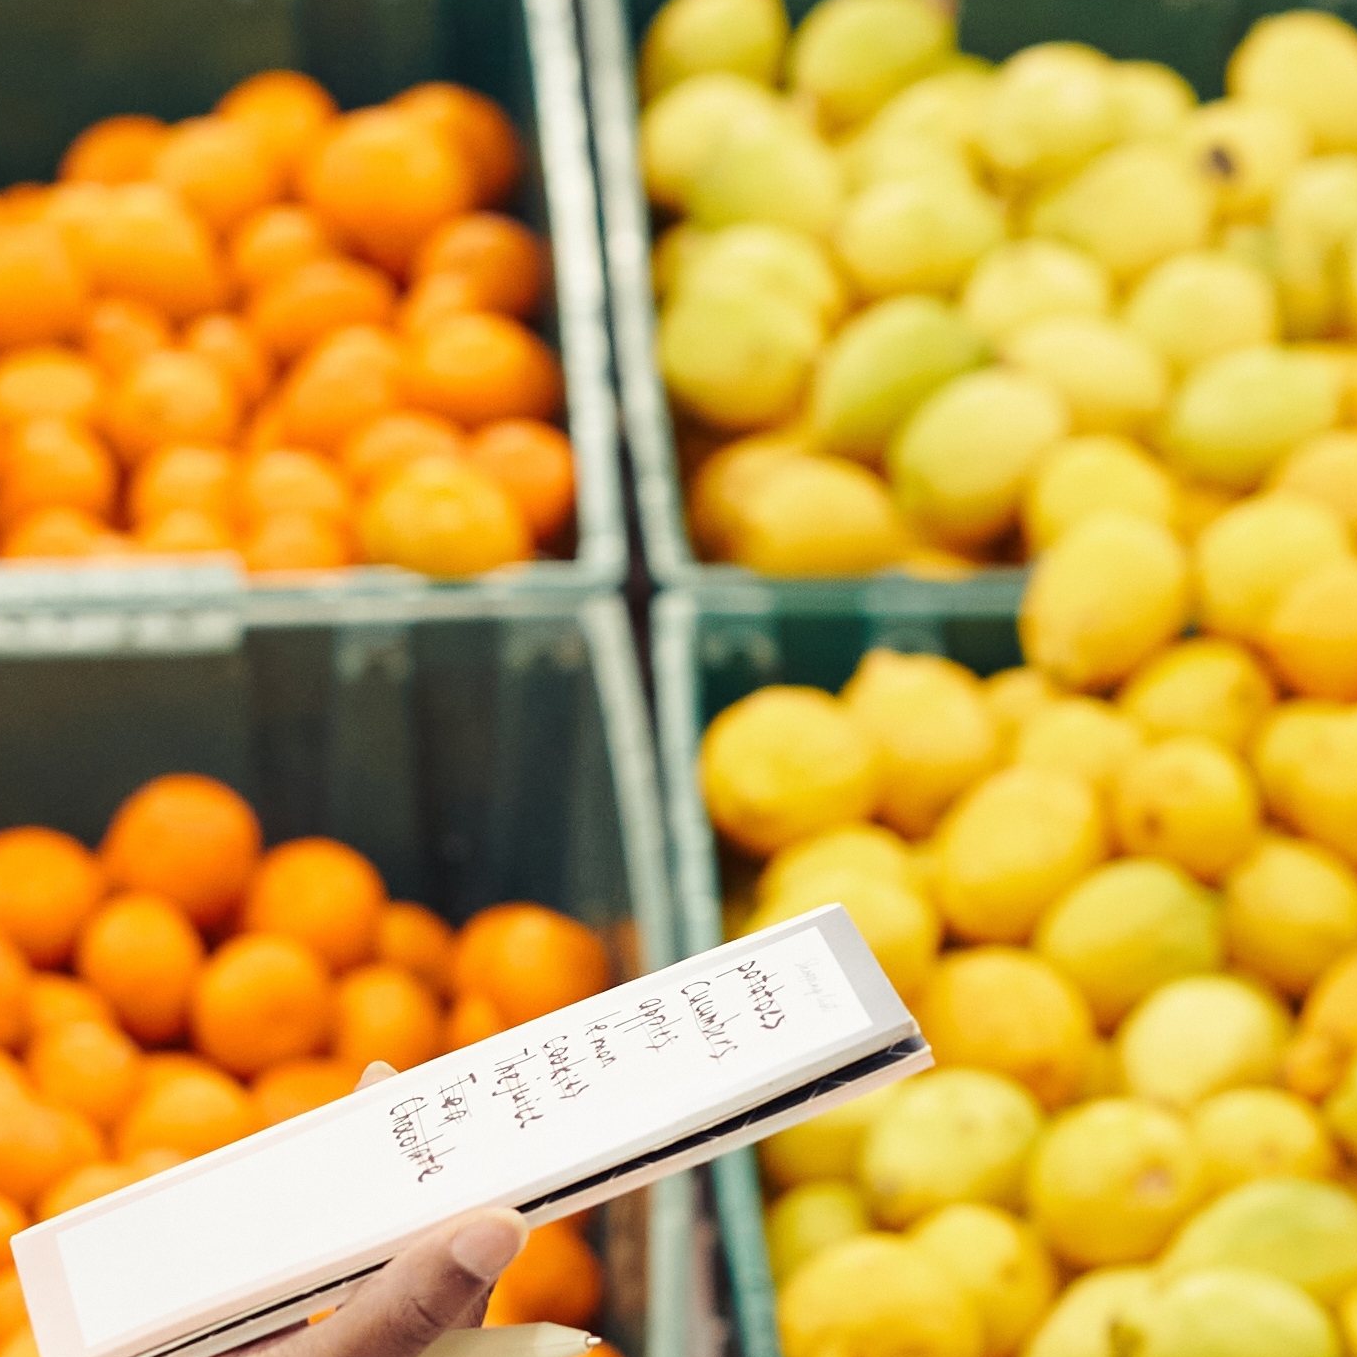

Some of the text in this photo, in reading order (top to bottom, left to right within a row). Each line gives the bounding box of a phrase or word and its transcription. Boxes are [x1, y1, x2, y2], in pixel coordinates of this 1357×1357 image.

[716, 960, 787, 1029] potatoes
[584, 1011, 620, 1068] lemon
[614, 997, 681, 1050] apples
[543, 1035, 589, 1099] cookies
[437, 1074, 478, 1126] Tea
